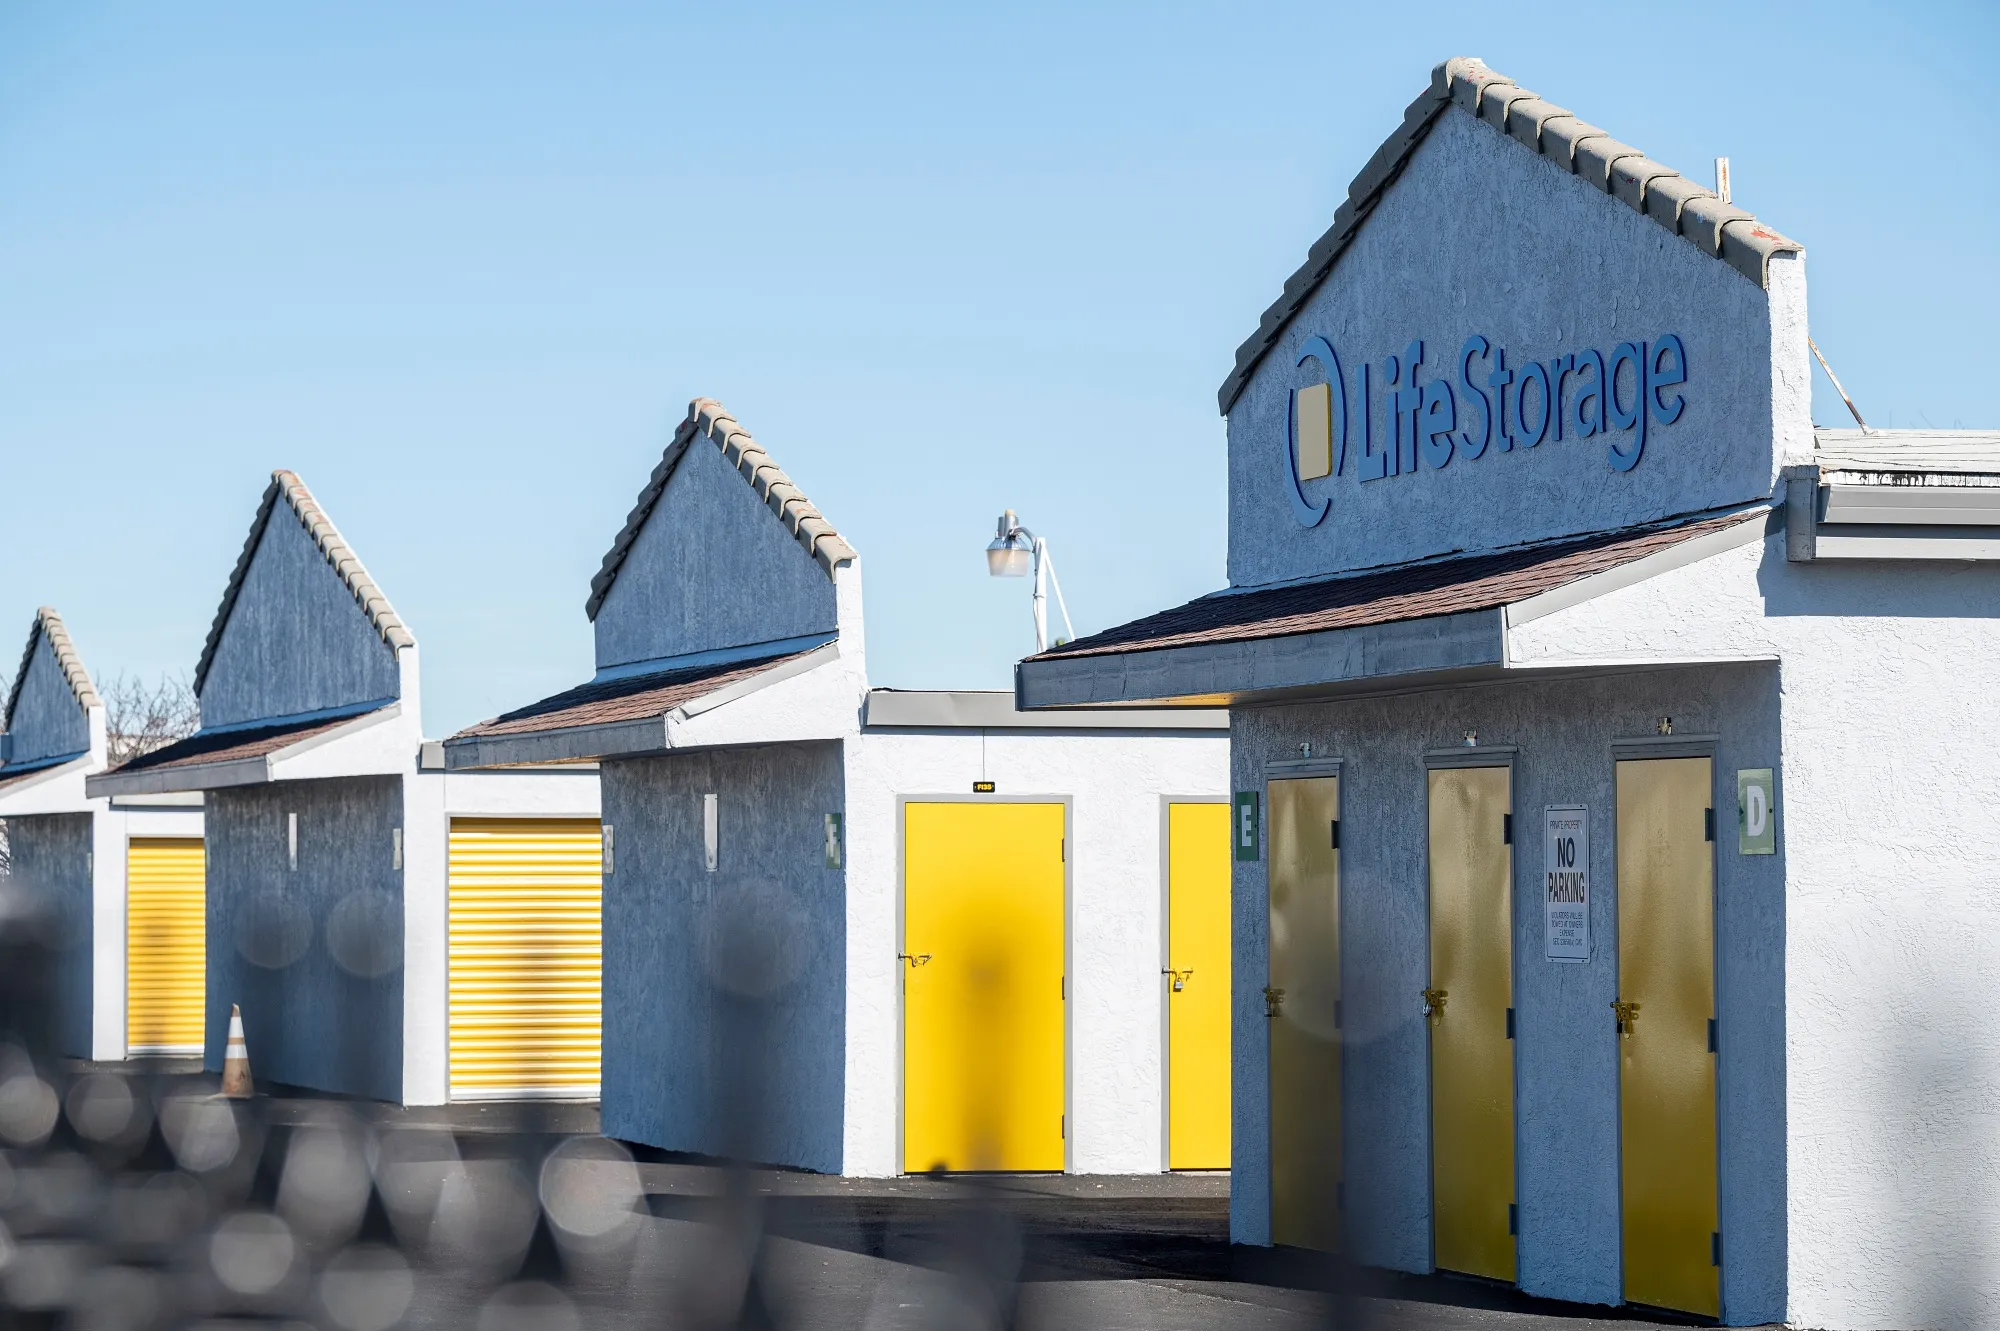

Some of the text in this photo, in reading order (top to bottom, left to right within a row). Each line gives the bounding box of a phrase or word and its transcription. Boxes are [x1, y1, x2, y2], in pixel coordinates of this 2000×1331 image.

[1241, 804, 1252, 847] E
[1747, 785, 1766, 836] D
[829, 823, 837, 858] F
[1557, 837, 1576, 868] NO
[1548, 872, 1585, 903] PARKING
